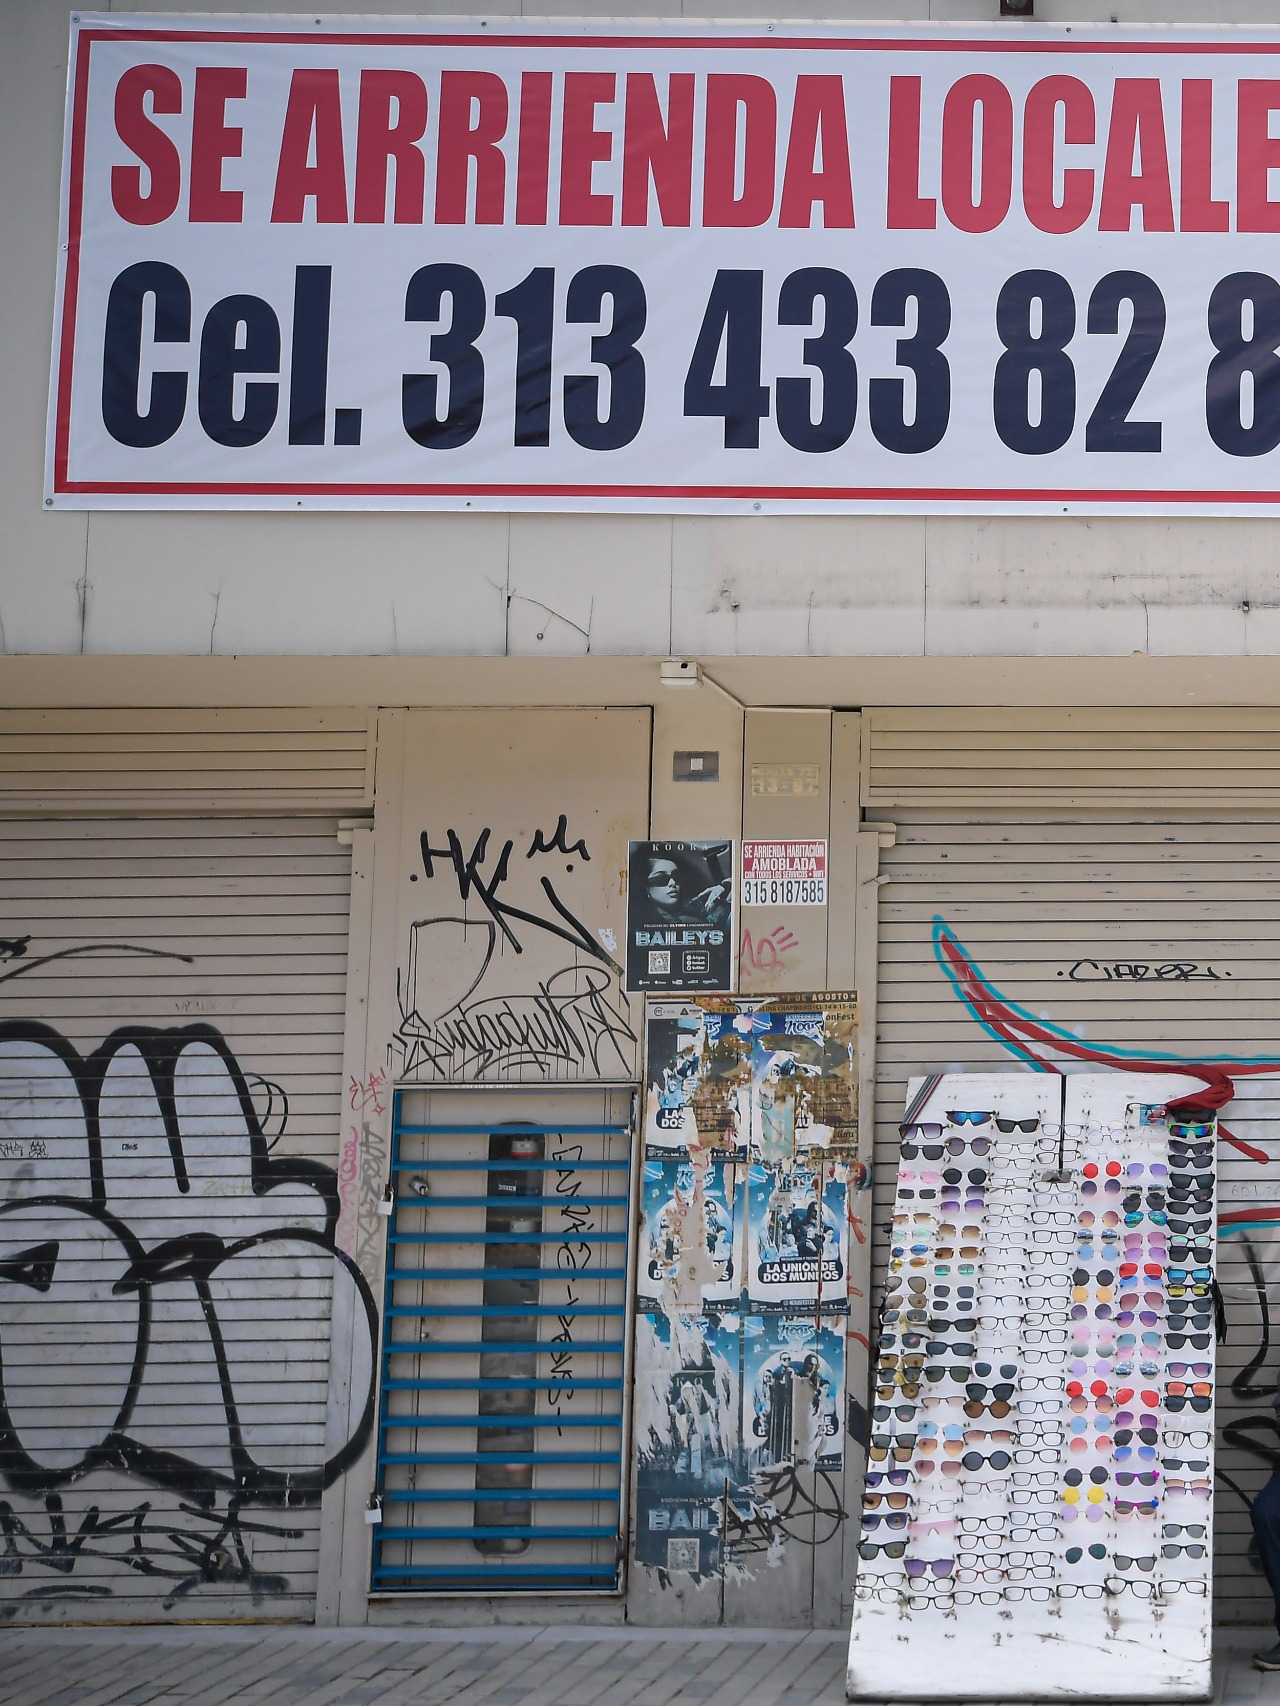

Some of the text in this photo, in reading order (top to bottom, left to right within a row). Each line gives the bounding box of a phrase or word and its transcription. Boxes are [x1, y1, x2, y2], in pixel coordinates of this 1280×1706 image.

[110, 63, 248, 226] SE
[270, 68, 856, 230] ARRIENDA
[101, 260, 362, 449] Cel.
[401, 262, 647, 450] 313
[683, 266, 952, 455] 433
[993, 268, 1167, 456] 82
[744, 841, 825, 858] SE ARRIENDA HABITACIÓN
[752, 858, 817, 871] AMOBLADA
[756, 871, 772, 879] TODOS
[772, 871, 782, 879] LOS
[812, 870, 824, 878] WIFI
[744, 880, 824, 904] 315 8187585
[635, 930, 724, 946] BAILEYS
[811, 992, 849, 1001] AGOSTO
[766, 1261, 836, 1273] LA UNIÓN DE
[763, 1271, 839, 1283] DOS MUNDOS
